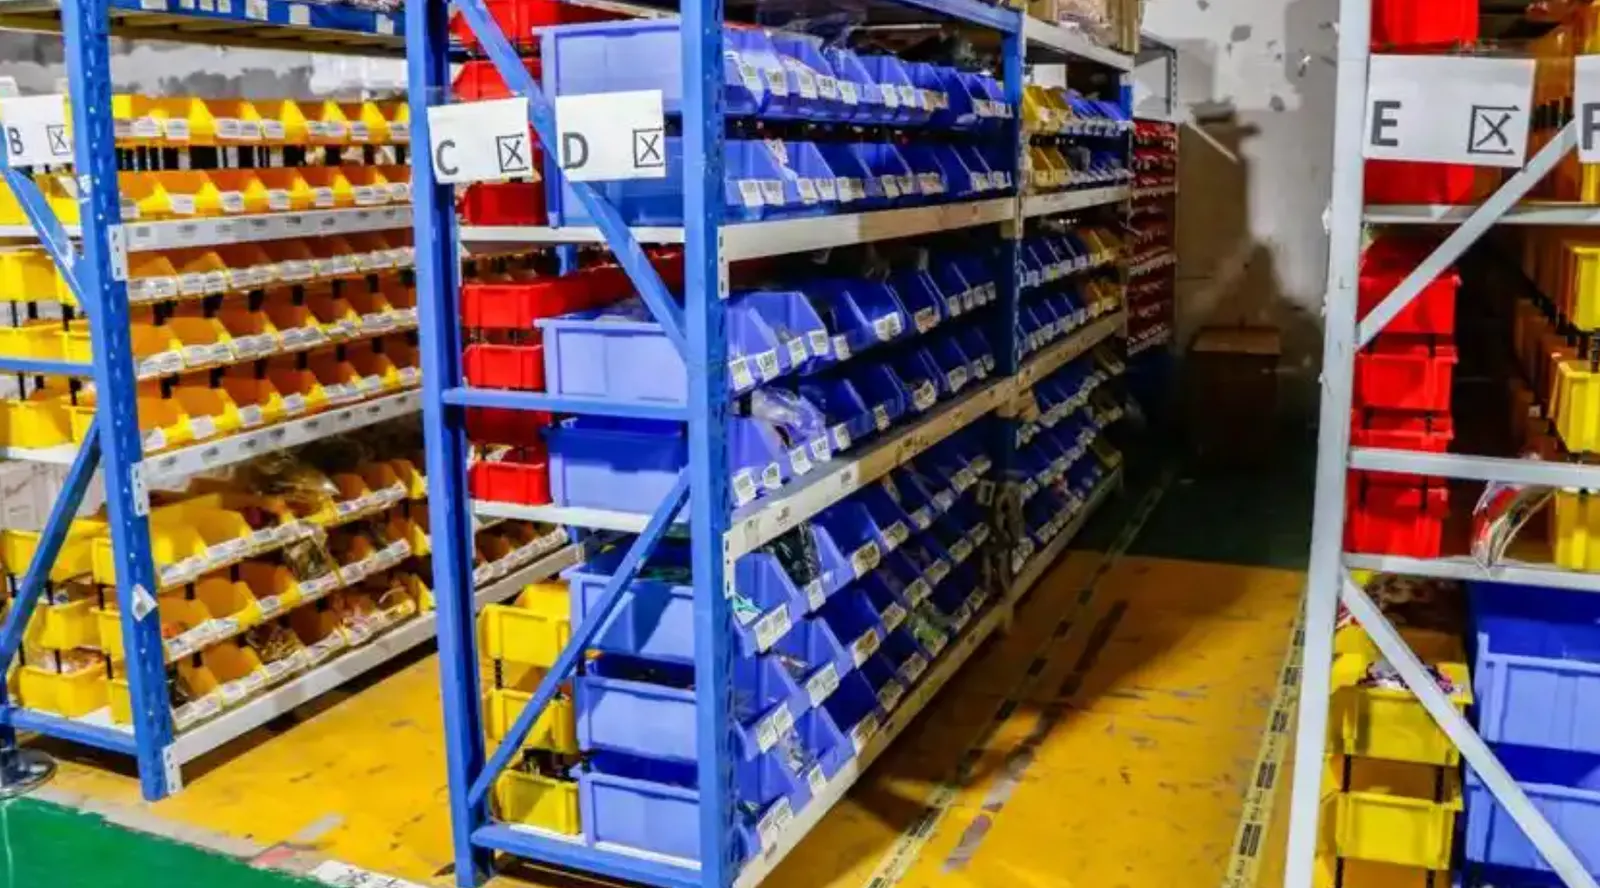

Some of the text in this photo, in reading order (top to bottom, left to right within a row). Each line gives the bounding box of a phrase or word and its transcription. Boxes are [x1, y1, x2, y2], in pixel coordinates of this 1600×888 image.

[7, 126, 24, 156] B
[1371, 100, 1402, 147] E
[435, 138, 459, 177] C
[562, 131, 589, 170] D
